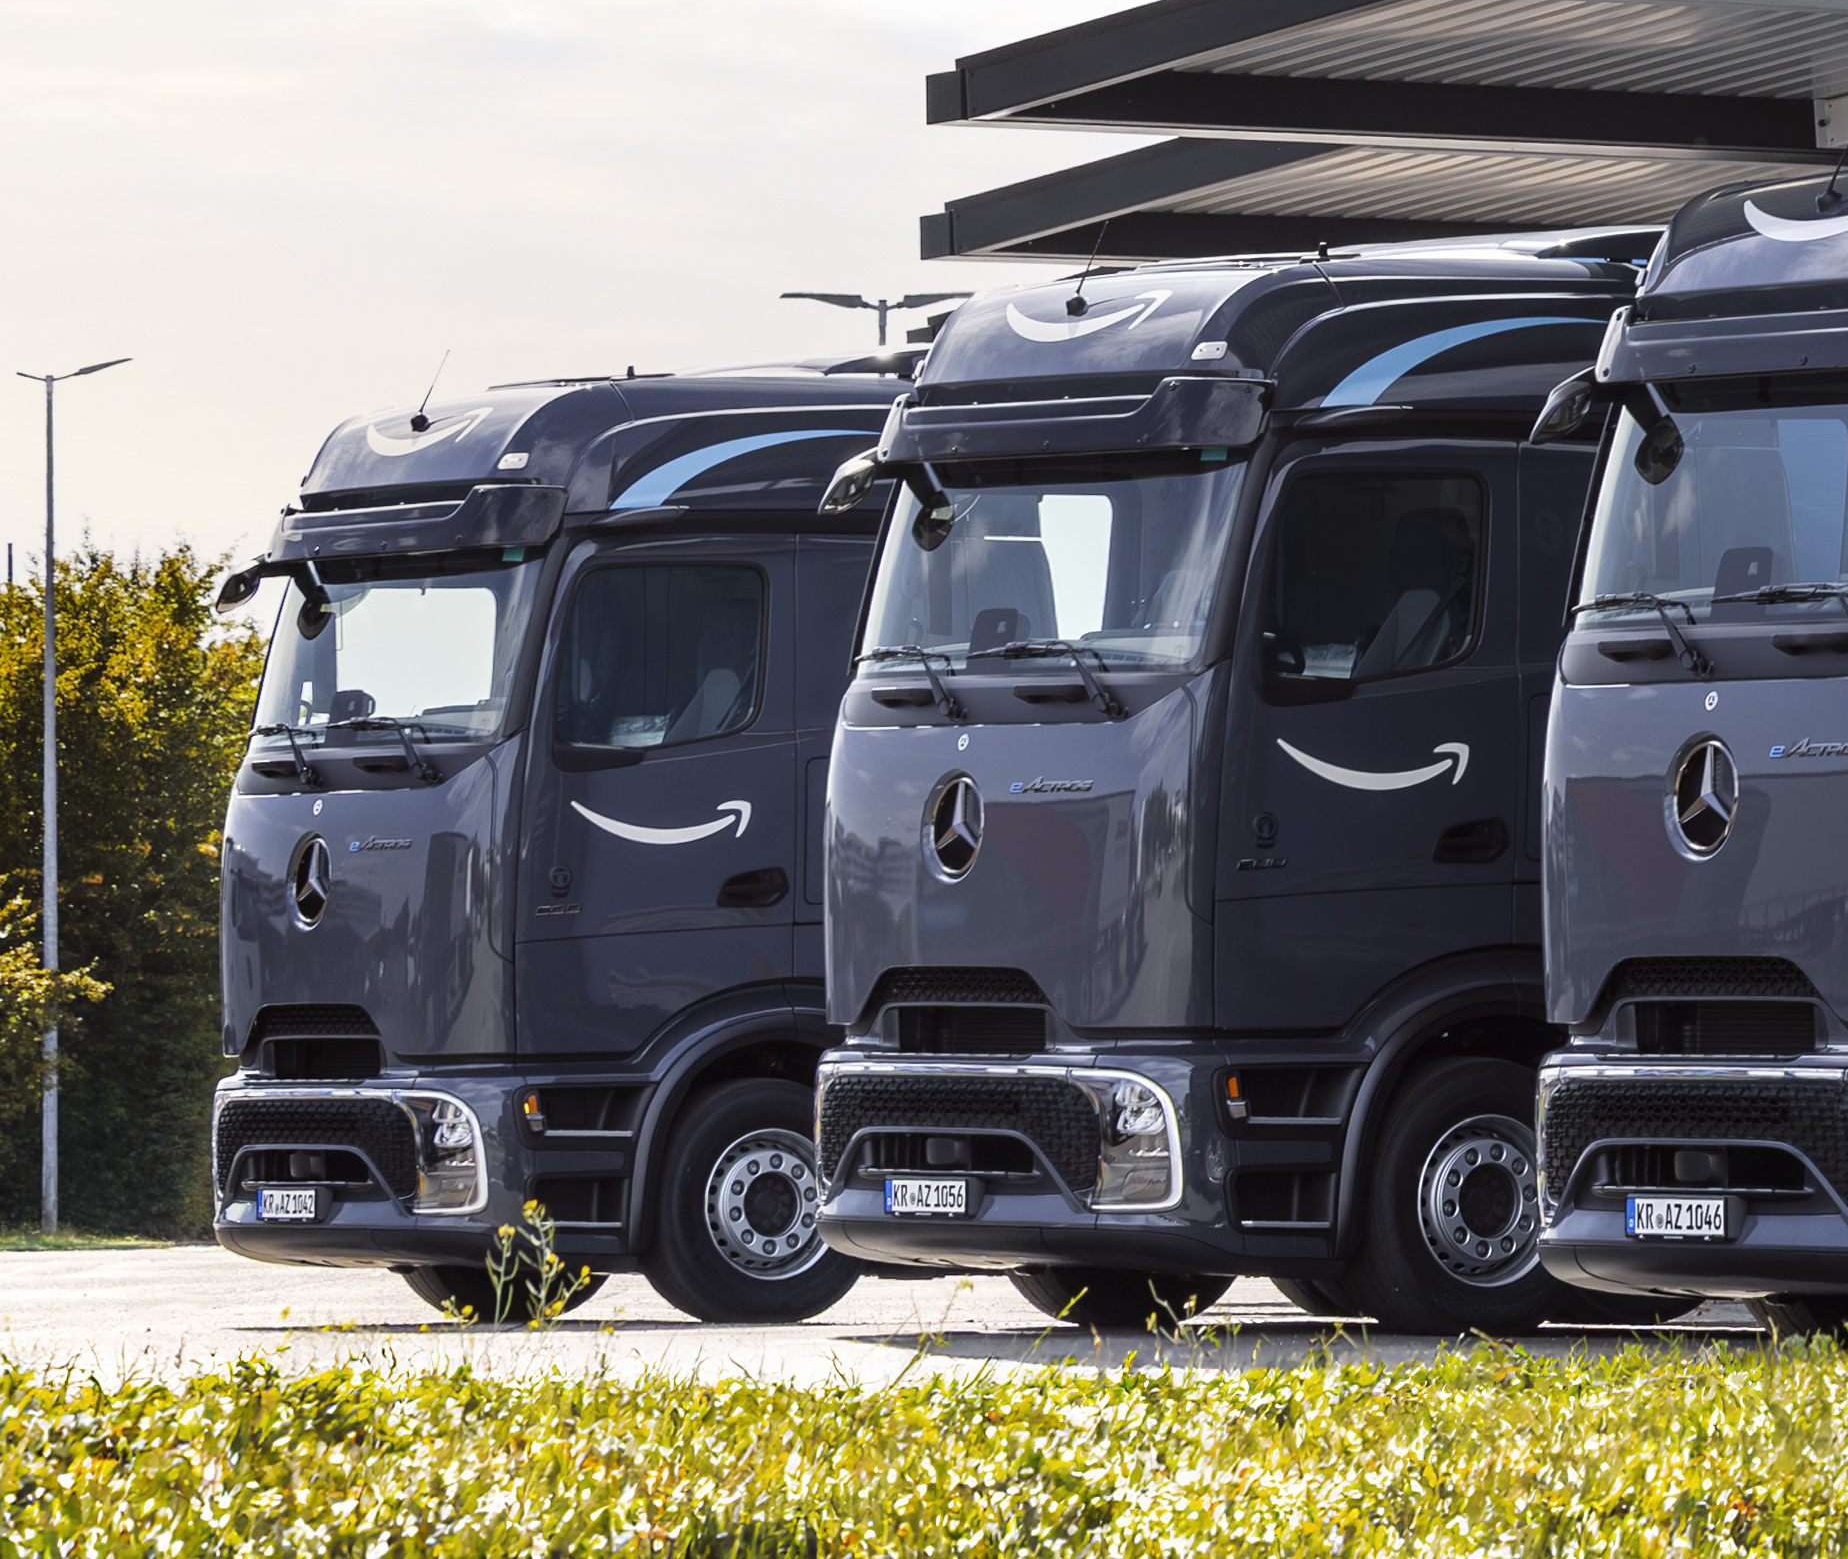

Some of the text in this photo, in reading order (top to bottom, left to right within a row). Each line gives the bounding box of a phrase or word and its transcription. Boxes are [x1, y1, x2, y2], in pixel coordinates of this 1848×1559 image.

[280, 1194, 290, 1214] AZ
[292, 1194, 314, 1214] 1042
[893, 1184, 908, 1207] KR
[916, 1184, 932, 1207] AZ
[933, 1184, 964, 1208] 1056
[1637, 1203, 1722, 1230] KR AZ 1046
